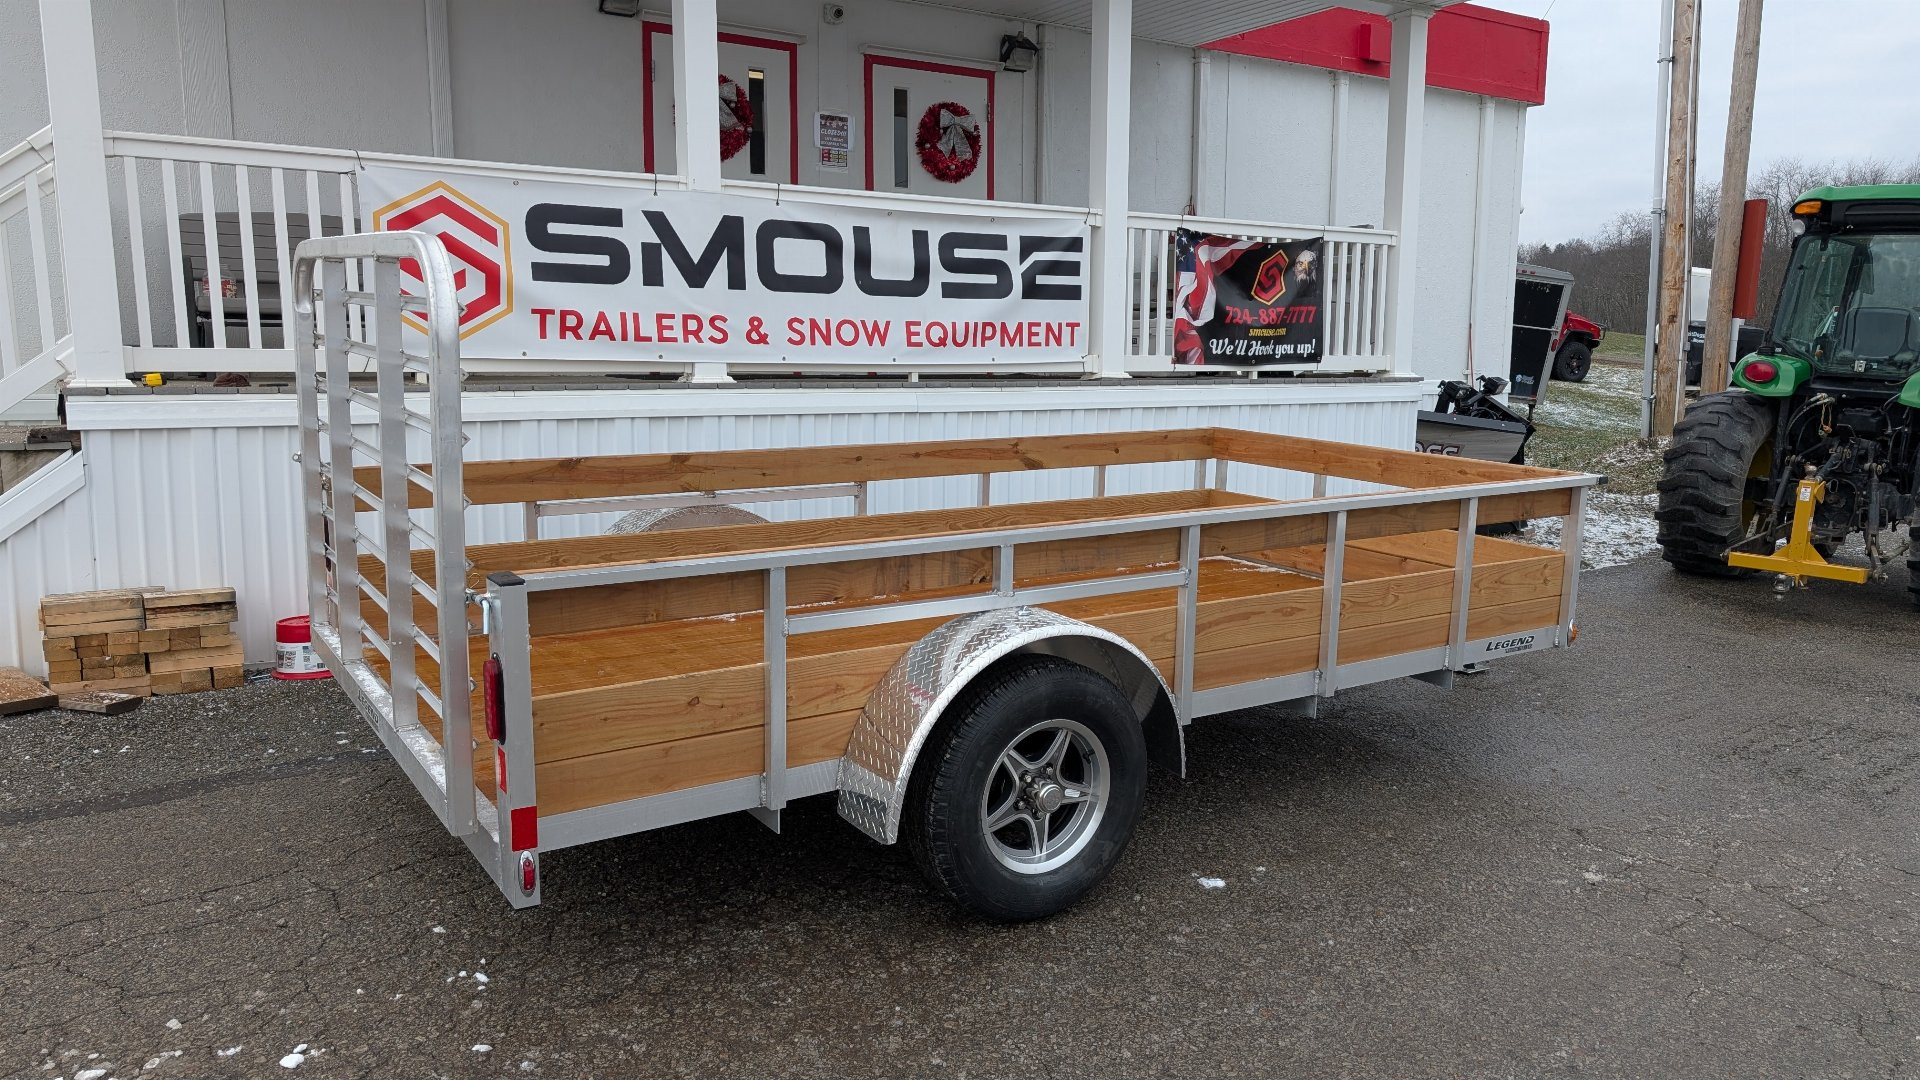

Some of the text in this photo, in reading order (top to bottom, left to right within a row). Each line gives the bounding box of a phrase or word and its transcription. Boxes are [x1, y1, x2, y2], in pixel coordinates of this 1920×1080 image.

[525, 203, 1083, 300] SMOUSE
[1224, 305, 1317, 325] 724-887-7777
[531, 308, 1081, 348] TRAILERS & SNOW EQUIPMENT
[1209, 337, 1316, 358] We'll Hook you up!
[1485, 635, 1535, 652] LEGEND
